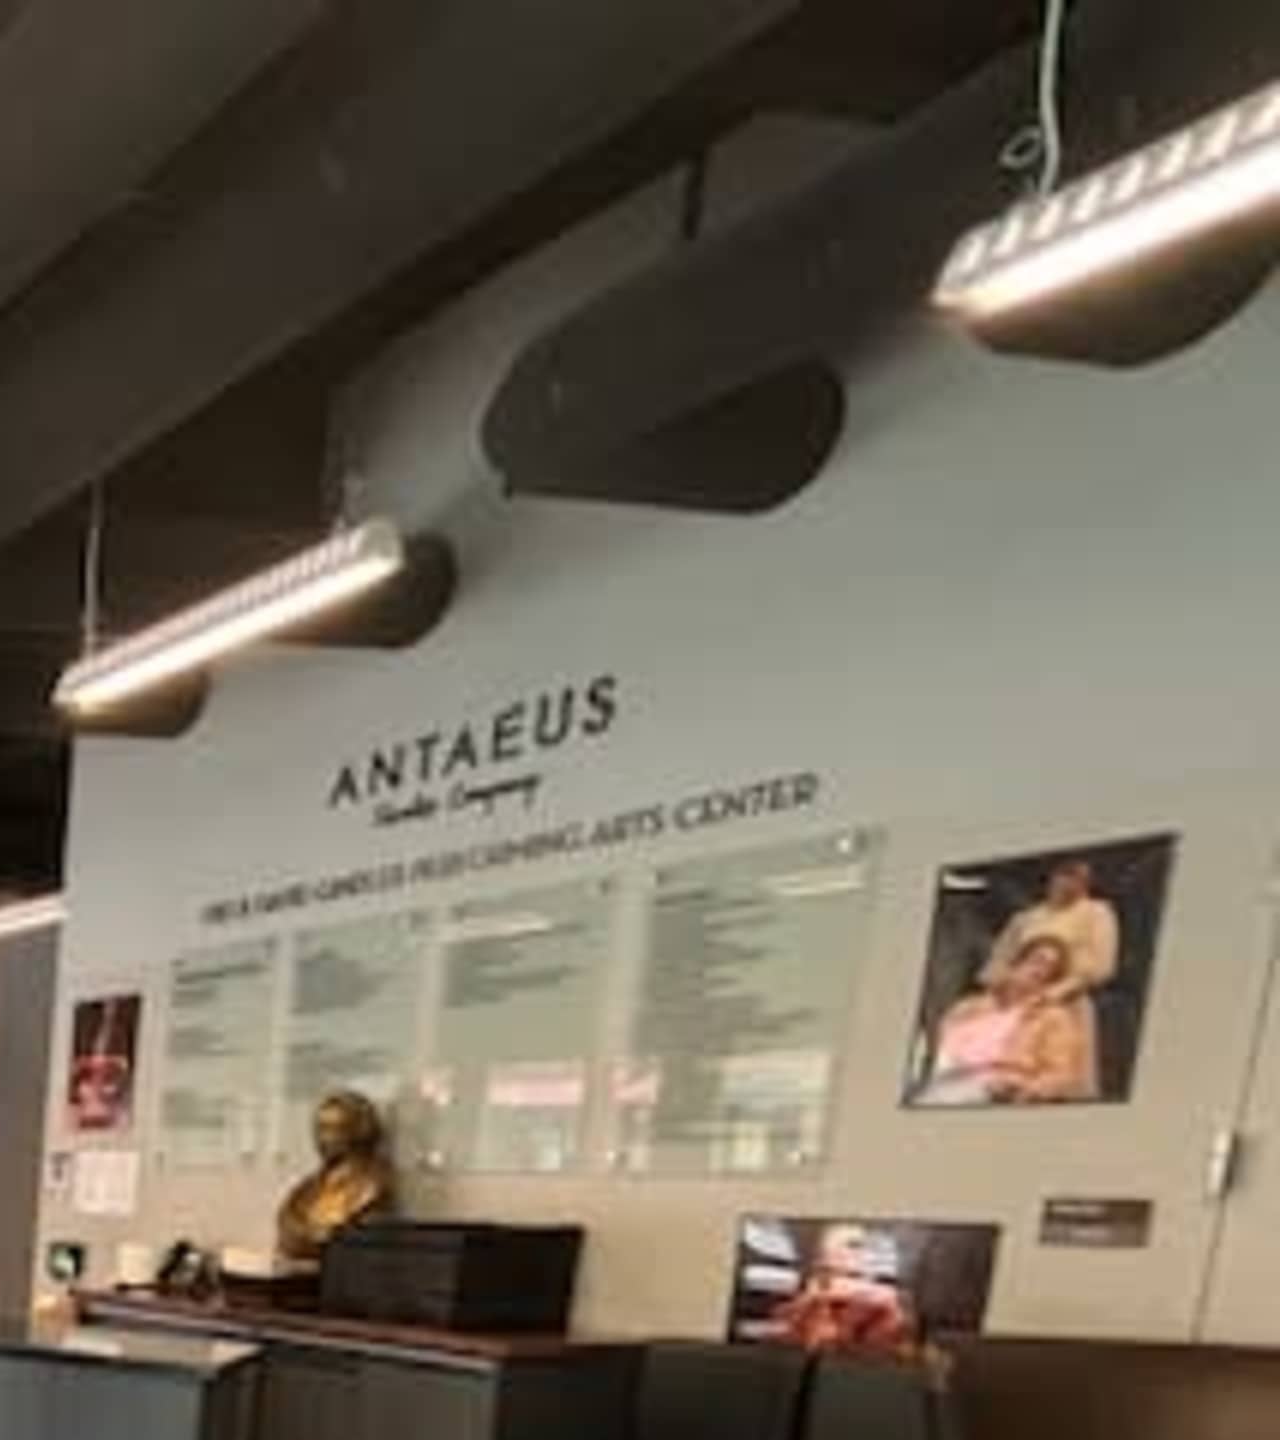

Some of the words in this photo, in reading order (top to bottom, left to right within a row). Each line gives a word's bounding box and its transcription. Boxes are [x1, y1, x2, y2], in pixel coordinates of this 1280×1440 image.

[327, 674, 617, 806] ANTAEUS
[589, 803, 664, 846] ARTS
[672, 771, 819, 831] CENTER
